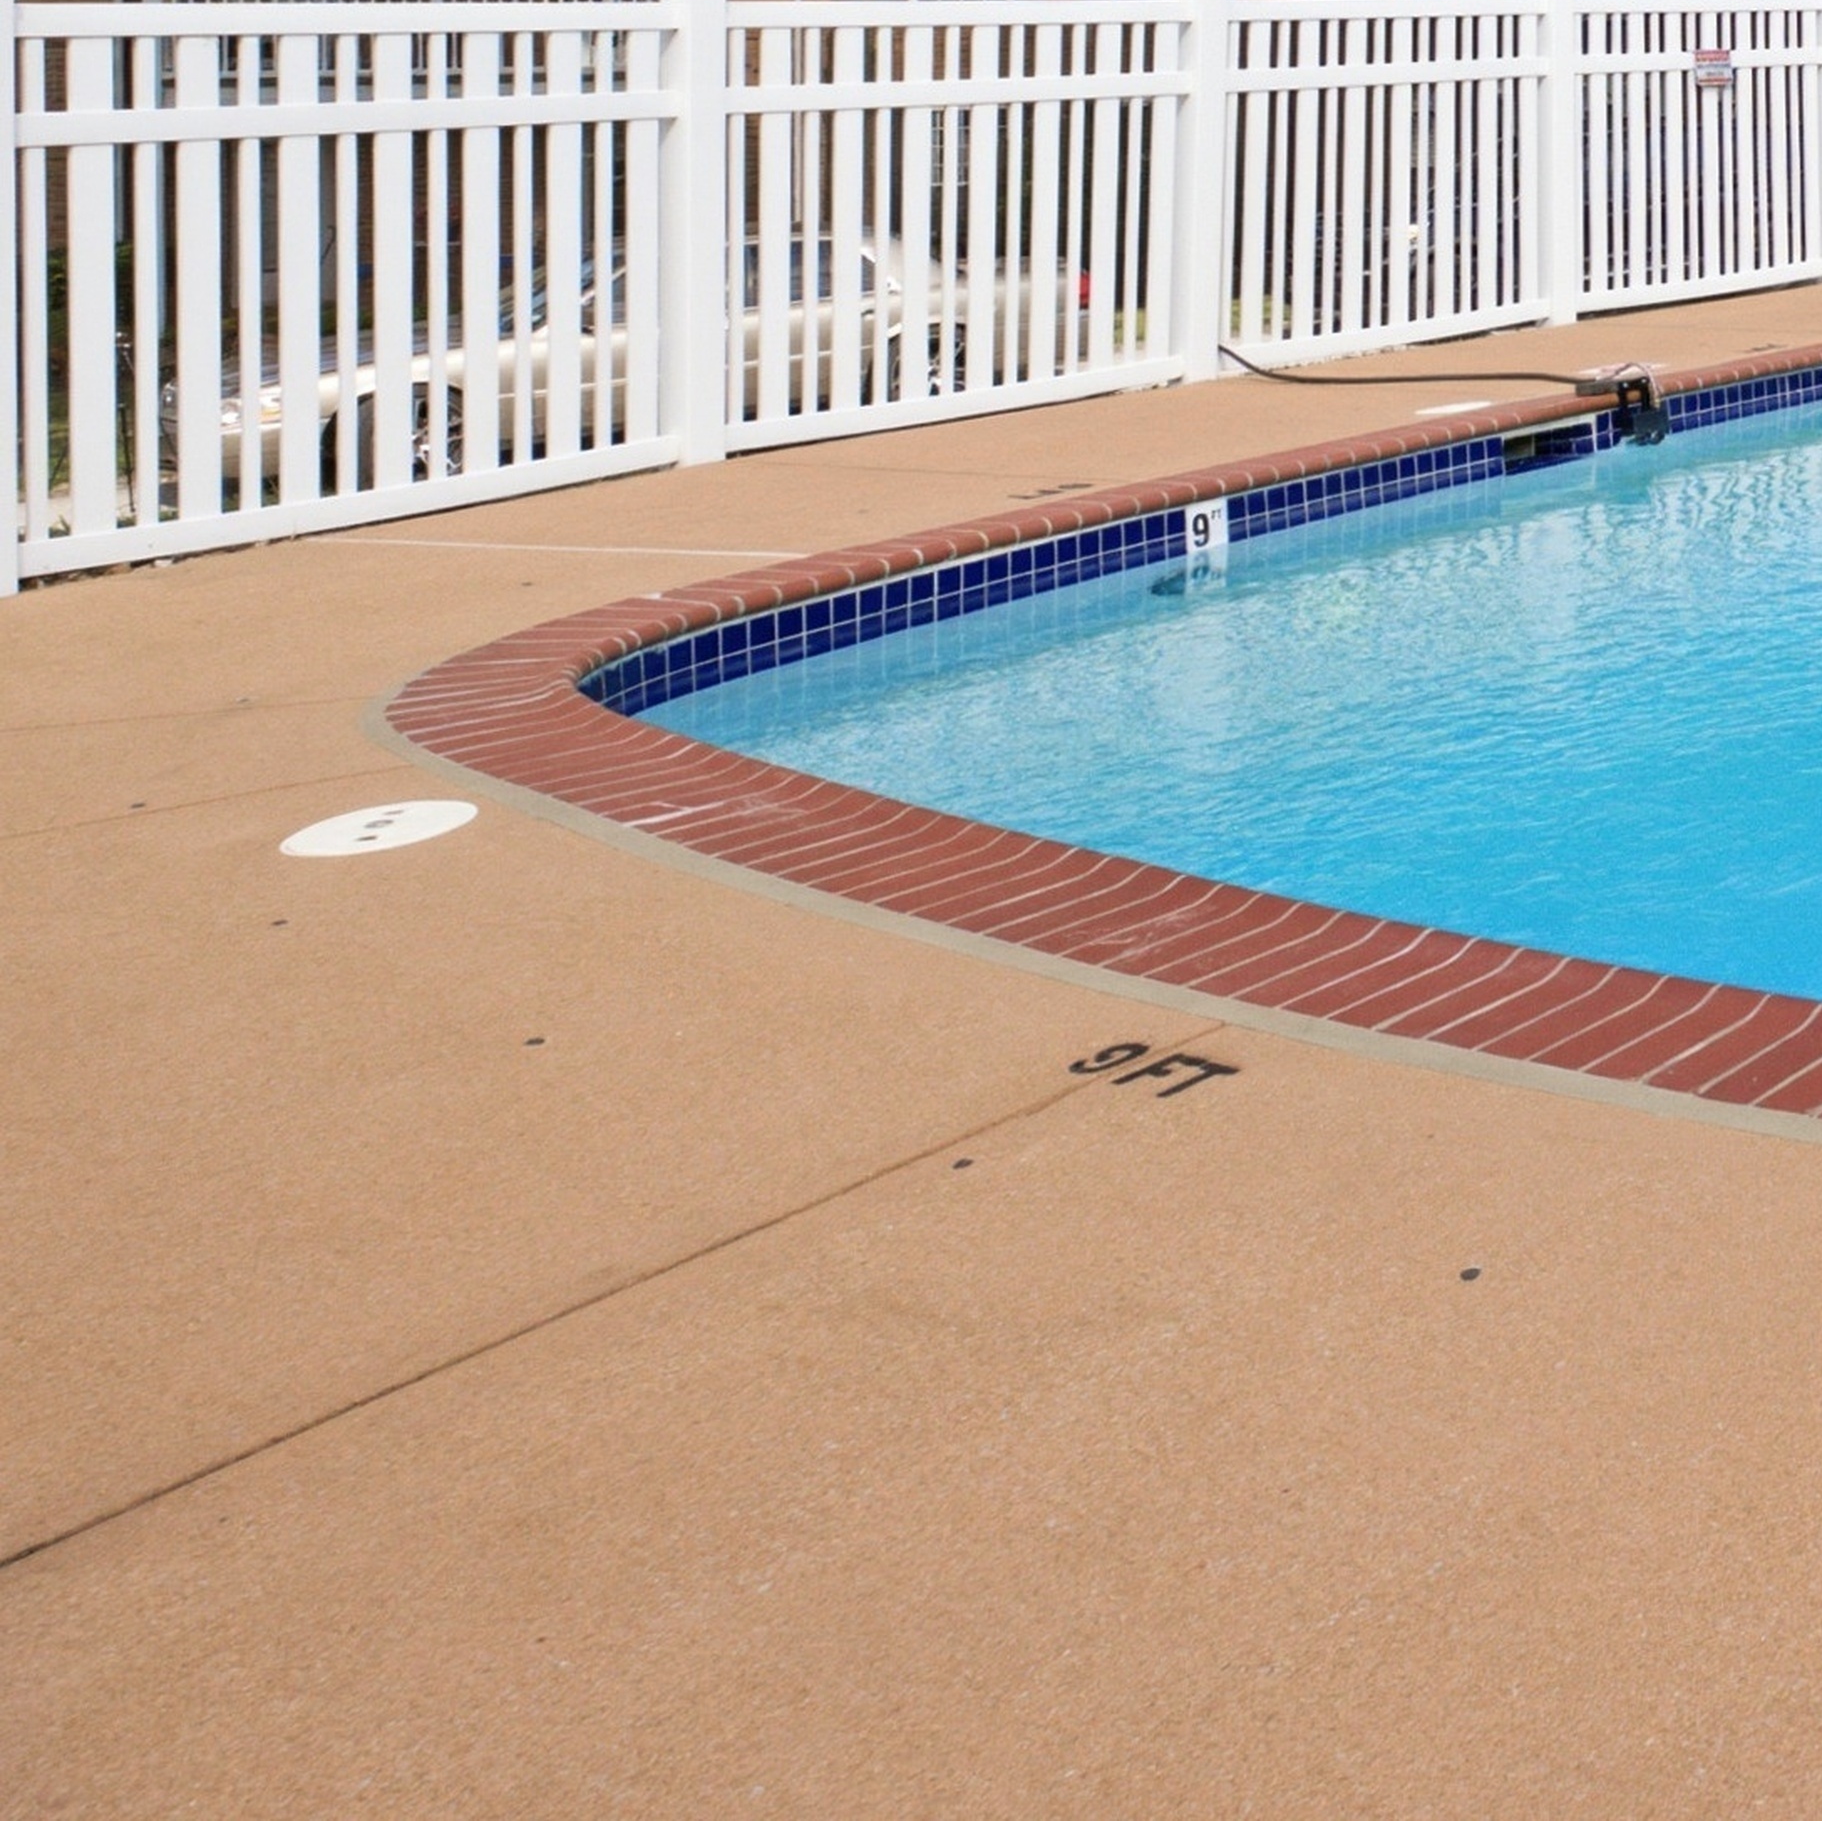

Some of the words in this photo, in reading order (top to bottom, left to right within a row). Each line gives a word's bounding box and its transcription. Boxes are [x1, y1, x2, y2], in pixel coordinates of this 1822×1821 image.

[1192, 513, 1210, 548] 9
[1069, 1043, 1150, 1074] 9
[1111, 1053, 1241, 1098] FT
